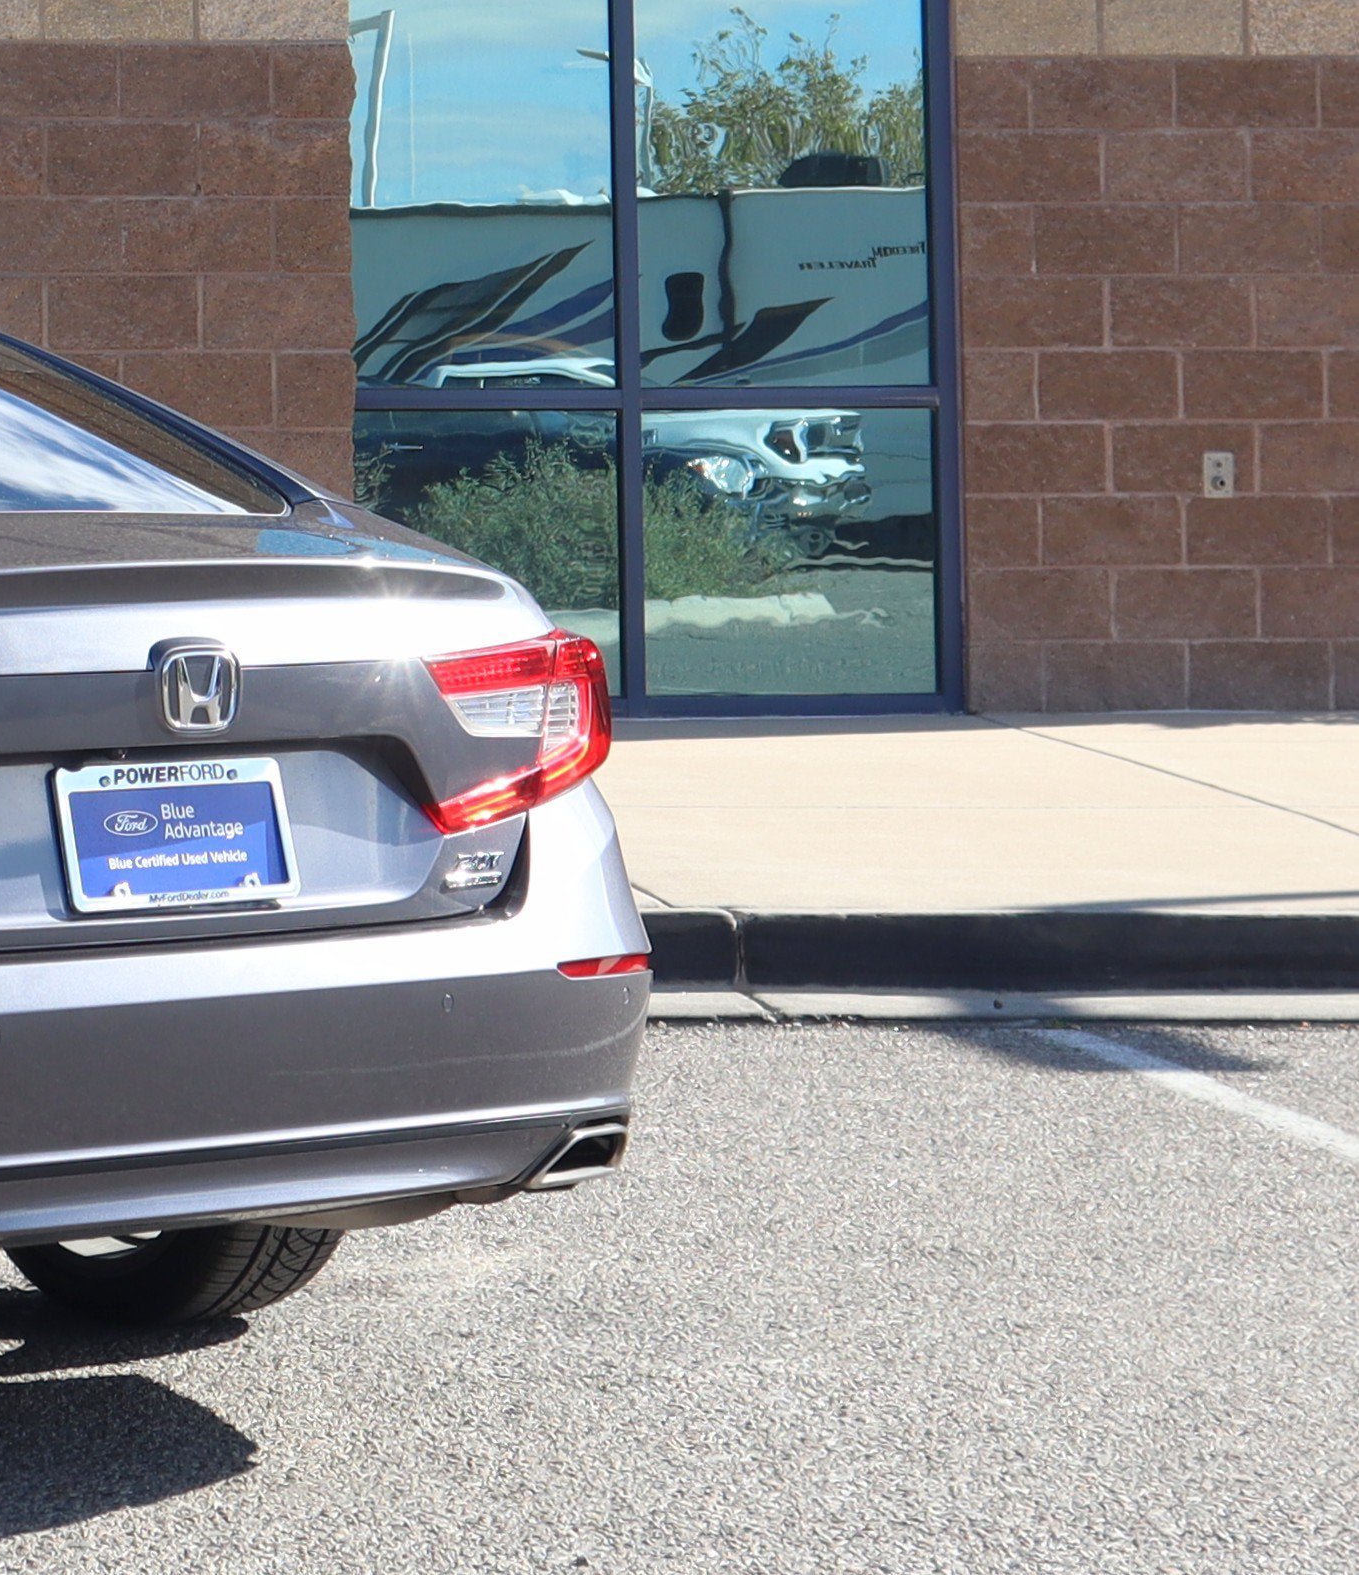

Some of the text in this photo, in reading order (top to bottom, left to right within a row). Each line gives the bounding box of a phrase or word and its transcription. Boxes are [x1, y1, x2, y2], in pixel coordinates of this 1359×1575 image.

[113, 763, 225, 786] POWERFORD
[160, 803, 195, 820] Blue
[114, 813, 148, 832] Ford
[164, 820, 244, 840] Advantage
[108, 849, 248, 870] Blue Certified Used Vehicle
[148, 889, 230, 904] MyFordDealer.com
